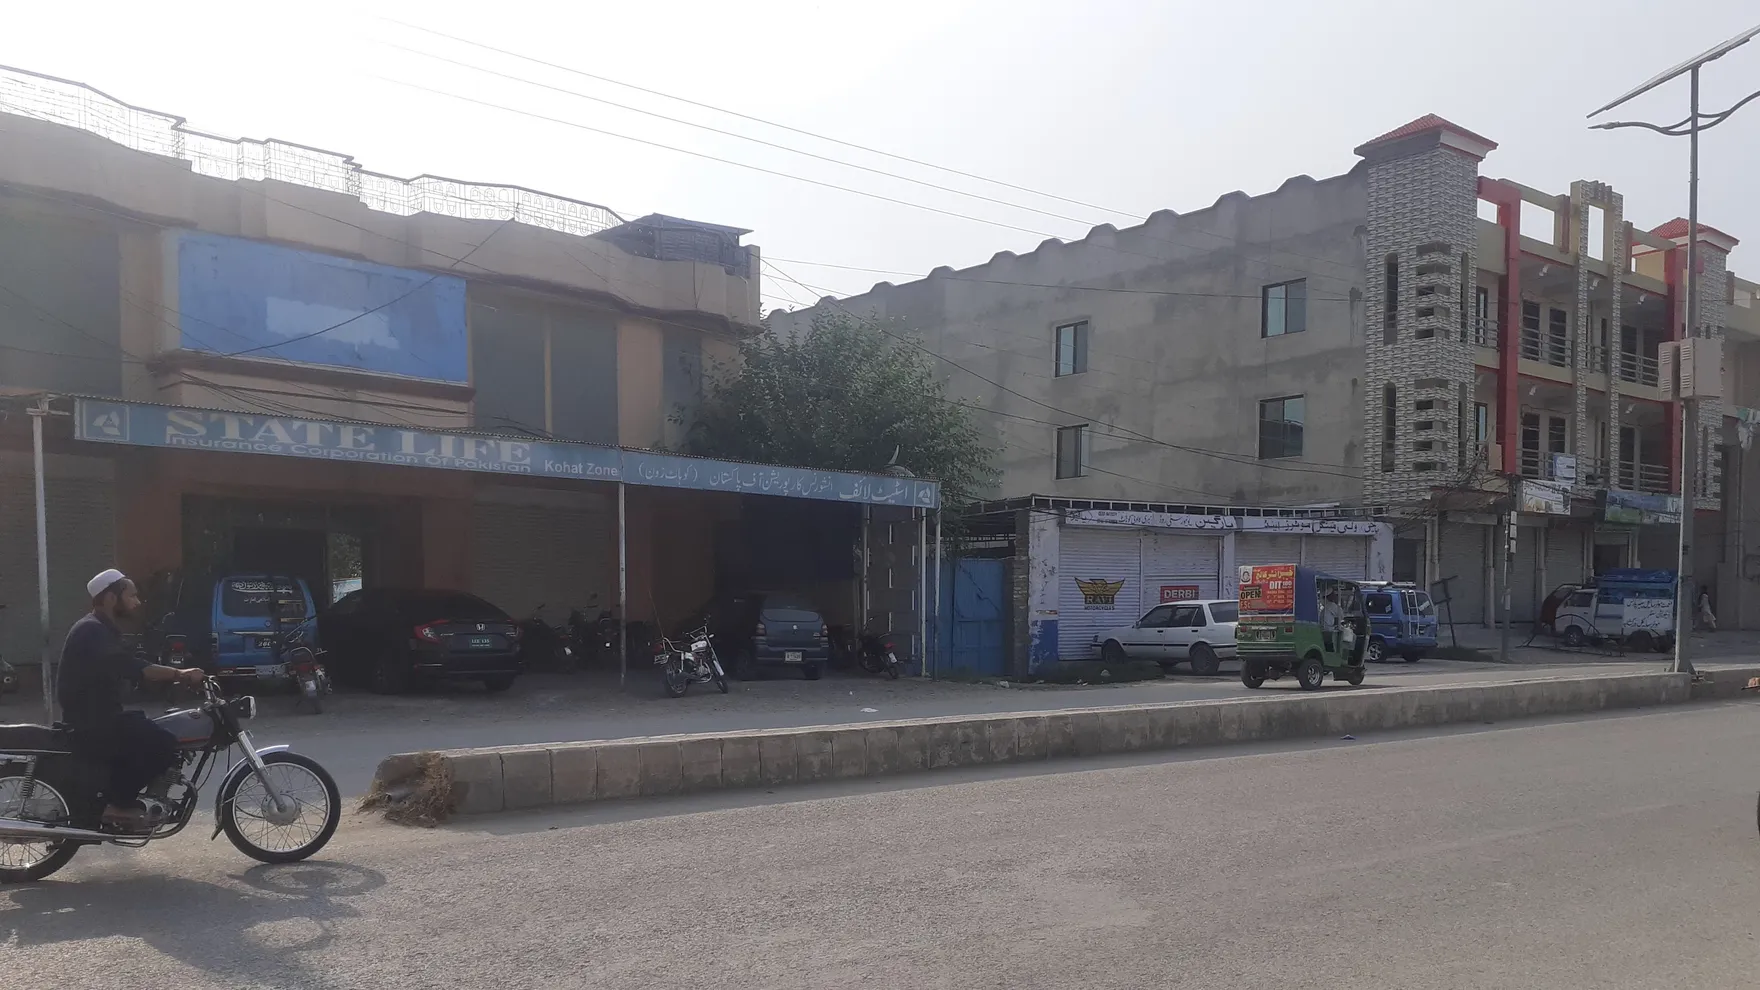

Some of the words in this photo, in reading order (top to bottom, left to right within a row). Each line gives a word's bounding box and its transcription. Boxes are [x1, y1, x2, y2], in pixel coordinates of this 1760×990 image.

[166, 410, 375, 451] STATE
[398, 431, 531, 464] LIFE
[166, 434, 282, 452] Insurance
[291, 442, 418, 464] Corporation
[425, 455, 447, 467] Of
[454, 457, 531, 473] Pakistan
[544, 460, 583, 474] Kohat
[586, 463, 619, 477] Zone
[709, 466, 742, 491] پاکستان
[803, 473, 833, 495] انشورنس
[839, 477, 871, 500] لائف
[1195, 515, 1234, 529] بارگین
[1163, 589, 1196, 599] DERBI
[1269, 581, 1282, 590] DIT
[1086, 595, 1114, 604] RAVI
[1240, 590, 1262, 600] OPEN
